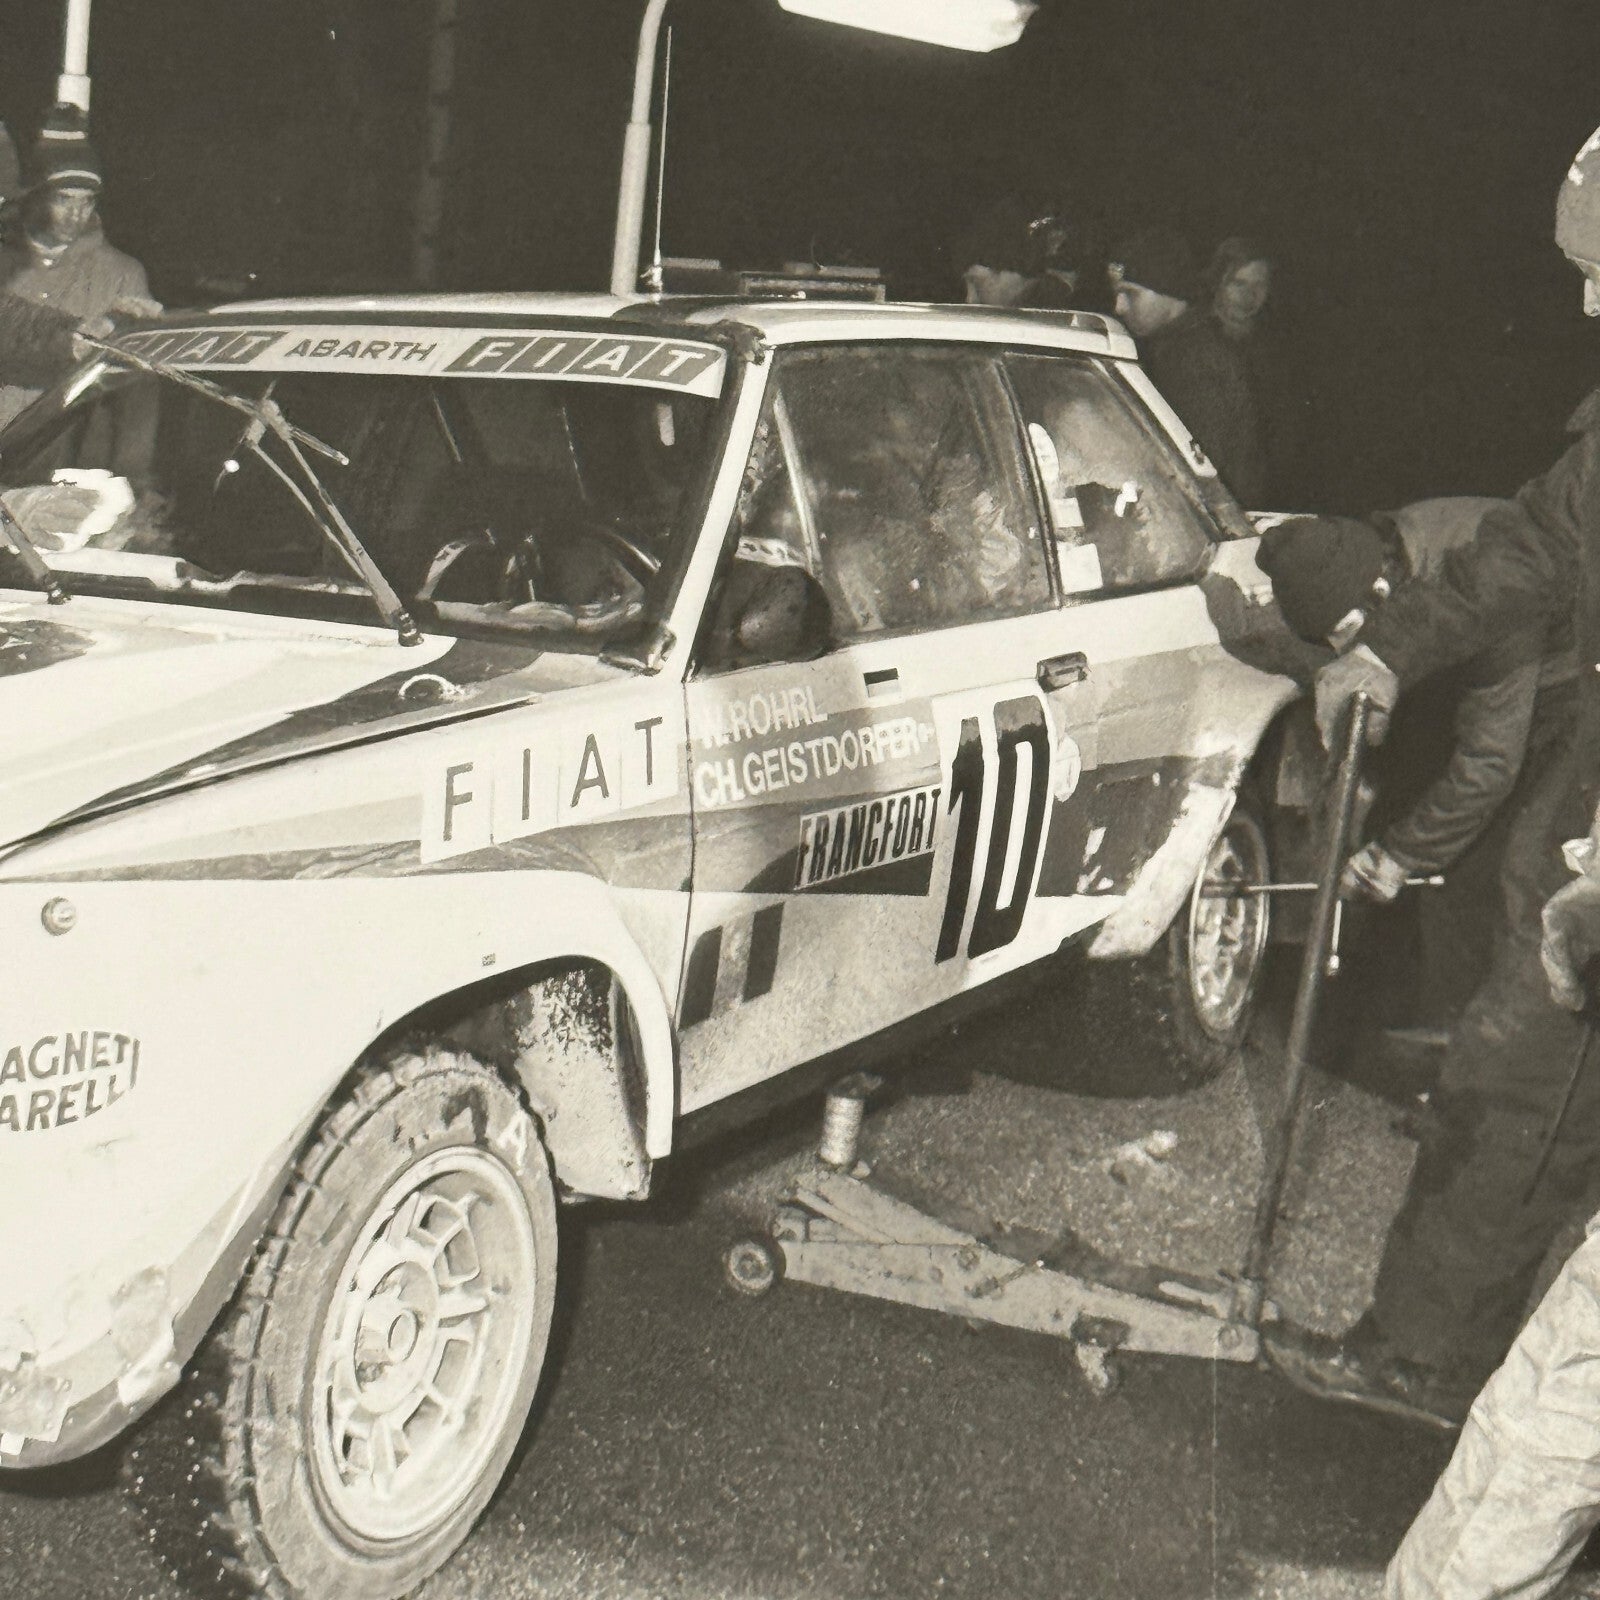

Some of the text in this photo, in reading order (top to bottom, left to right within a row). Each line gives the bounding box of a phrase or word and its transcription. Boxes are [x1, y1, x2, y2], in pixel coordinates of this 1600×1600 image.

[283, 339, 438, 361] ABARTH
[466, 341, 706, 376] FIAT
[443, 716, 664, 842] FIAT
[935, 695, 1051, 964] 10
[795, 788, 942, 887] FRANCFORT
